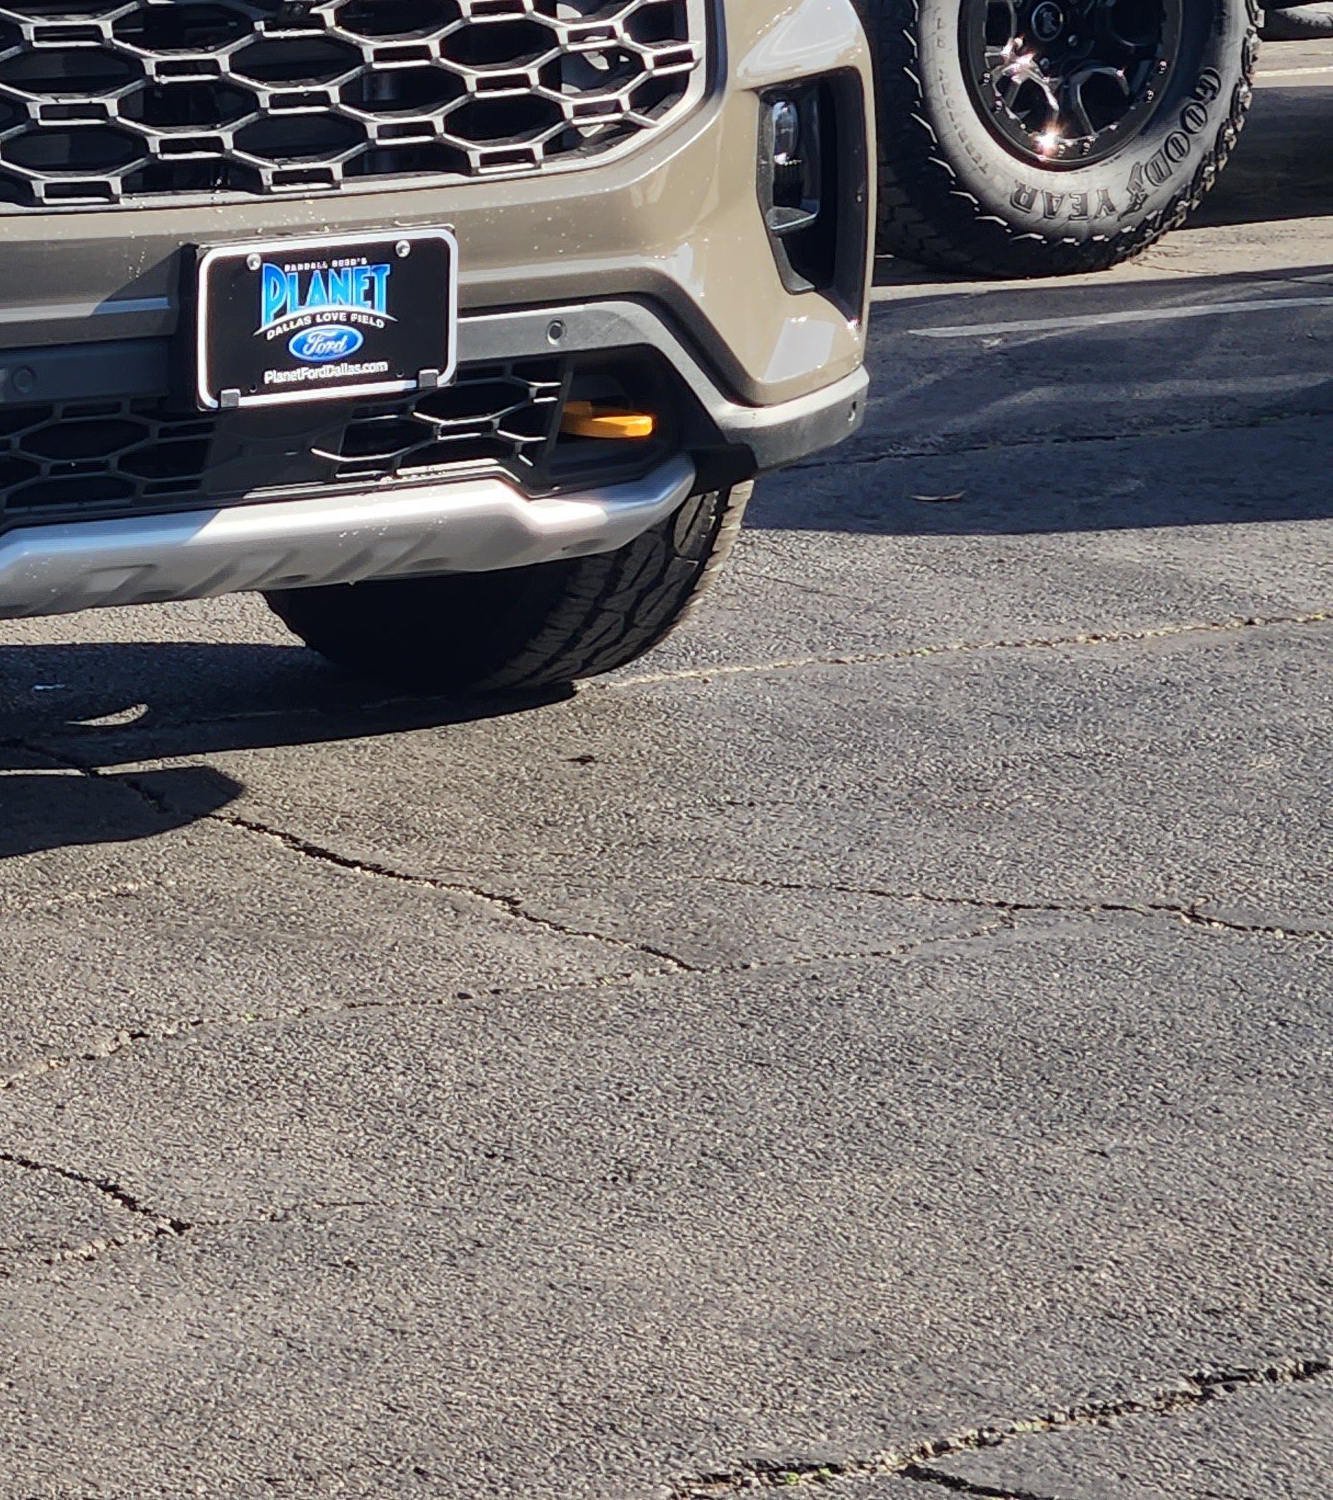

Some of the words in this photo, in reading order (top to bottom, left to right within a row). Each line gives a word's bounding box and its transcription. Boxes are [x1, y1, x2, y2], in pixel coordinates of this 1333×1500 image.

[1009, 67, 1221, 221] GOODYEAR
[261, 262, 391, 329] PLANET
[266, 315, 312, 341] DALLAS
[316, 312, 347, 323] LOVE
[350, 313, 385, 329] FIELD
[302, 331, 349, 356] Ford
[264, 361, 389, 385] PlanetFordDallas.com
